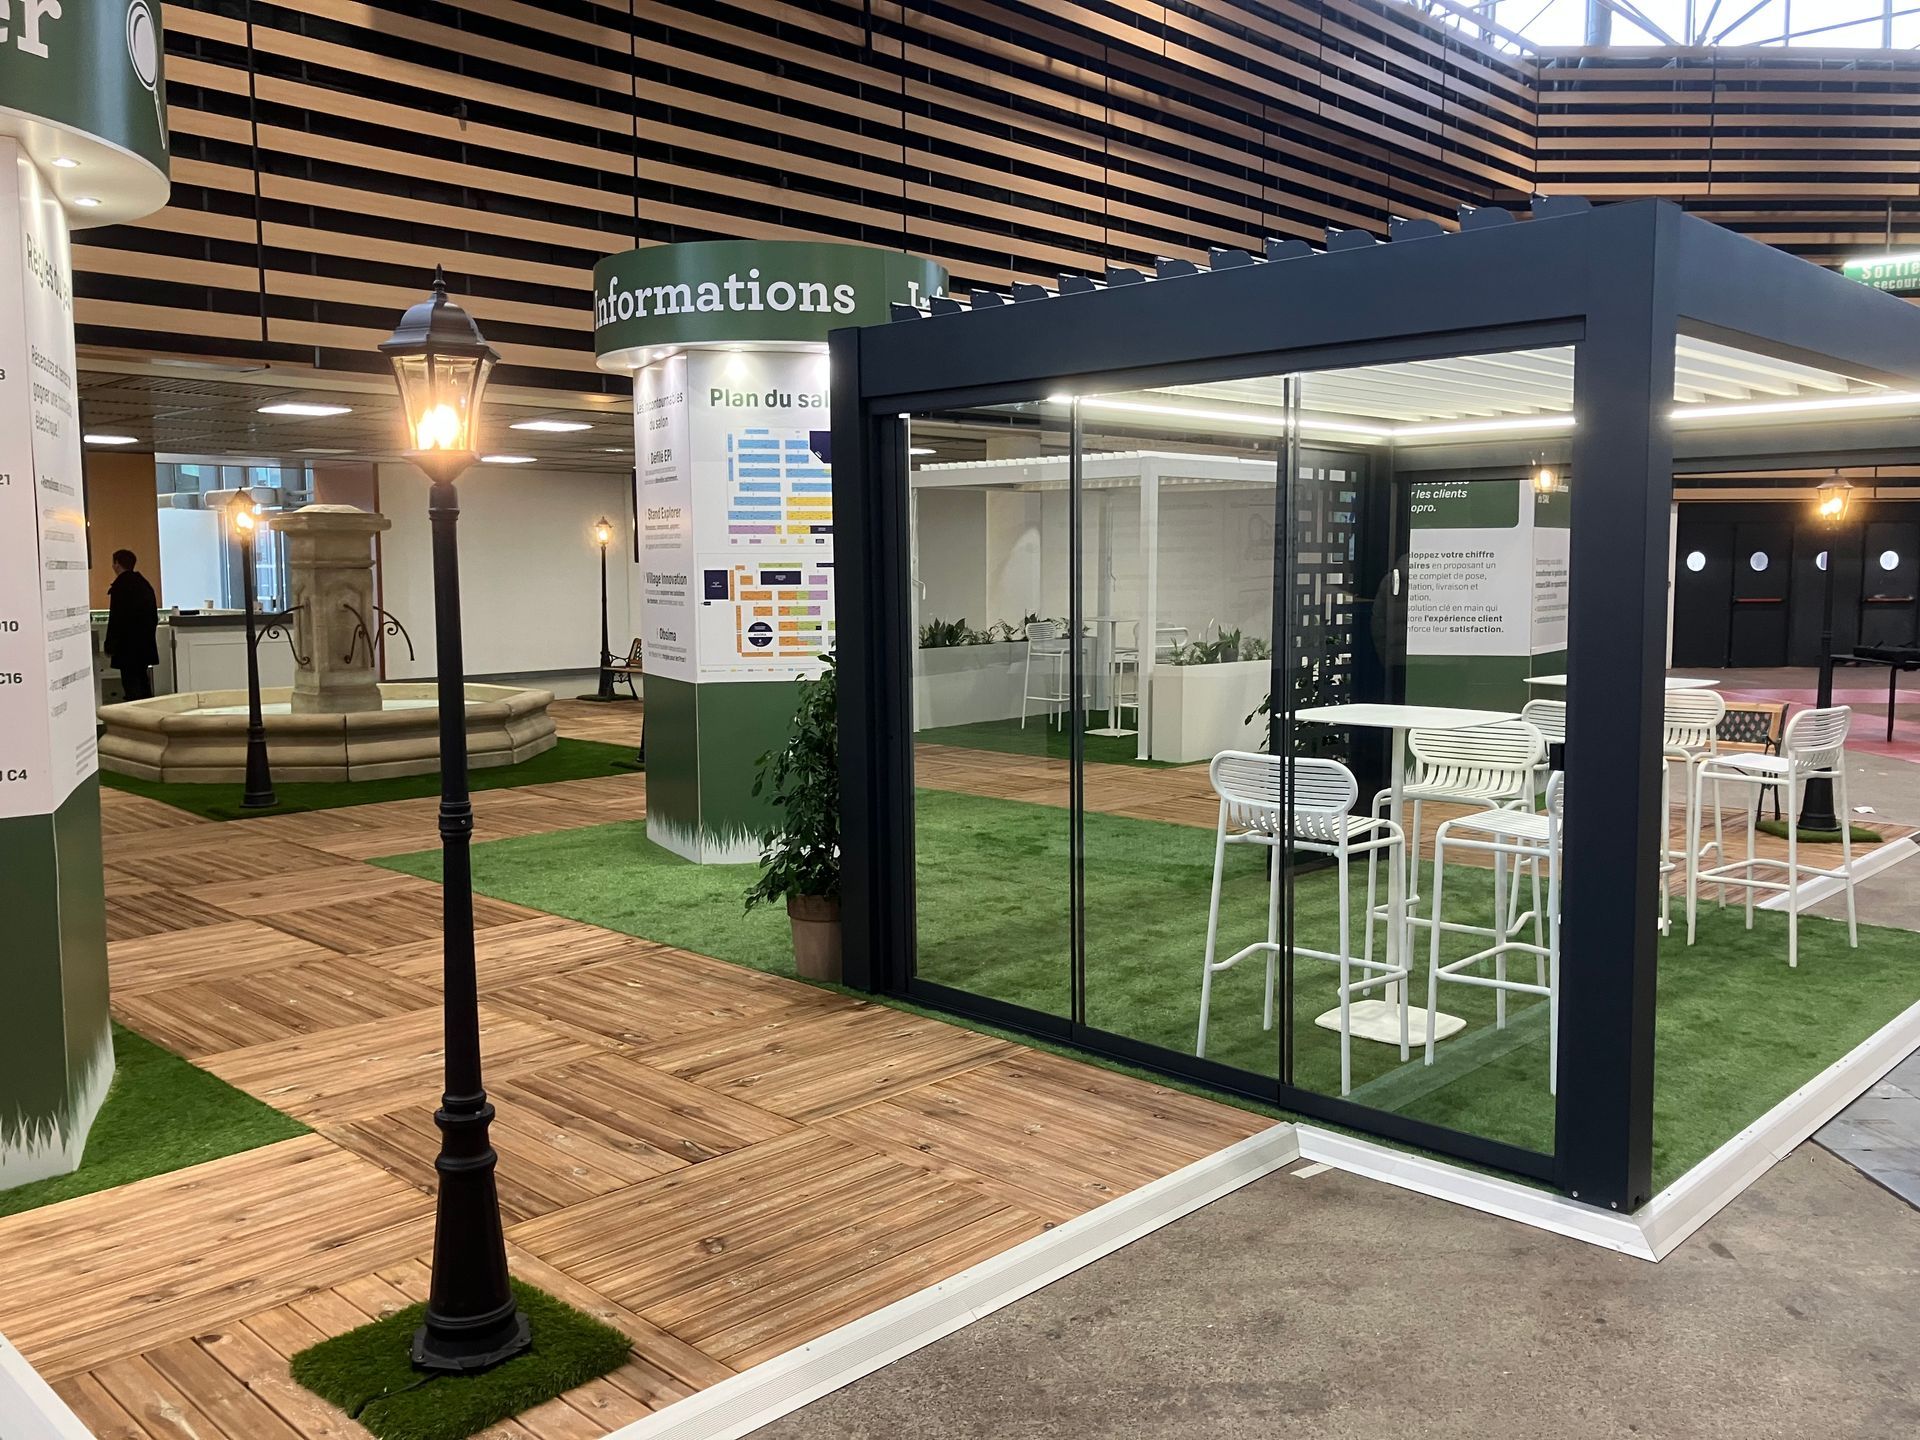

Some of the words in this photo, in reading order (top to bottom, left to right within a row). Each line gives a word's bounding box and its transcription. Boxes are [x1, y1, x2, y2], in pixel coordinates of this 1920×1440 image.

[1861, 259, 1920, 280] Sortie
[1873, 277, 1920, 290] secour
[595, 268, 856, 330] Informations
[710, 388, 759, 408] Plan
[765, 389, 792, 408] du
[1416, 489, 1431, 499] les
[1432, 489, 1468, 499] clients
[1441, 551, 1464, 559] votre
[1465, 550, 1495, 559] chiffre
[1443, 562, 1484, 571] proposant
[1419, 572, 1452, 581] complet
[1453, 572, 1464, 580] de
[1465, 573, 1488, 581] pose,
[1485, 604, 1498, 613] qui
[1424, 614, 1476, 623] l'expérience
[1477, 614, 1503, 622] client
[0, 620, 19, 632] 10
[1449, 625, 1504, 633] satisfaction.
[7, 769, 28, 781] C4
